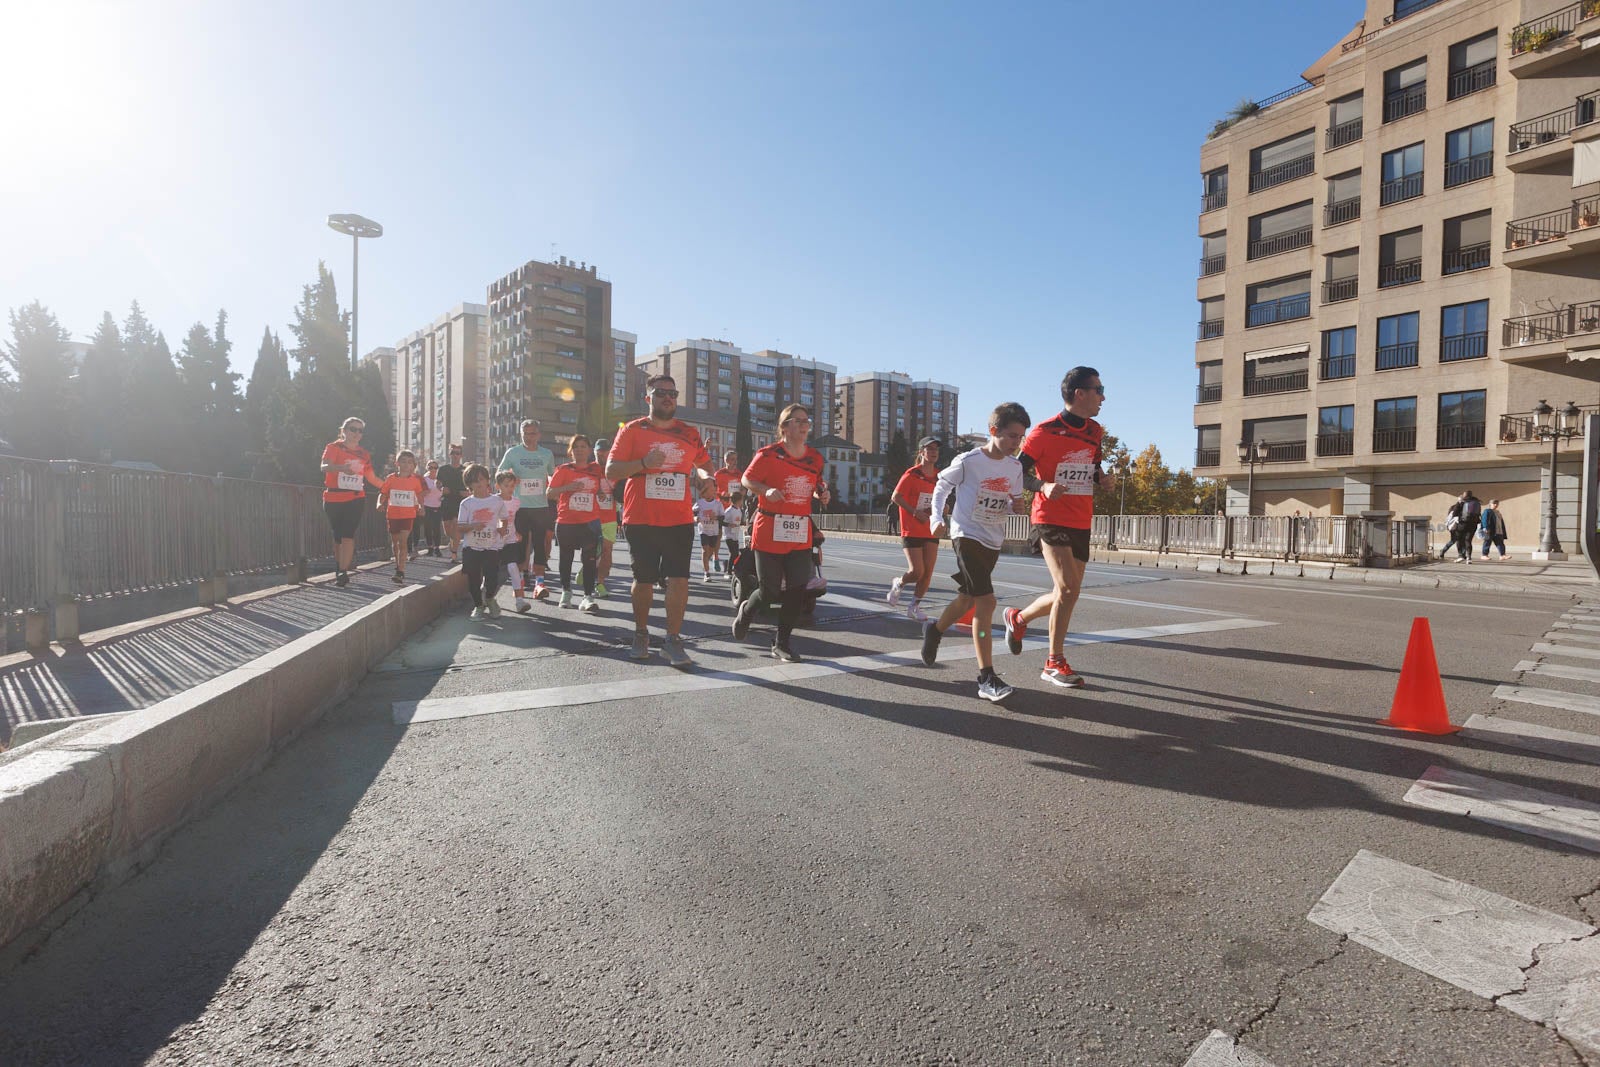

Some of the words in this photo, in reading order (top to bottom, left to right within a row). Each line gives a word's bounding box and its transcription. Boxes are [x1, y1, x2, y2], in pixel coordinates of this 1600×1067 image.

[1062, 470, 1088, 480] 1277
[655, 477, 675, 487] 690
[783, 521, 800, 530] 689
[472, 530, 491, 538] 1135
